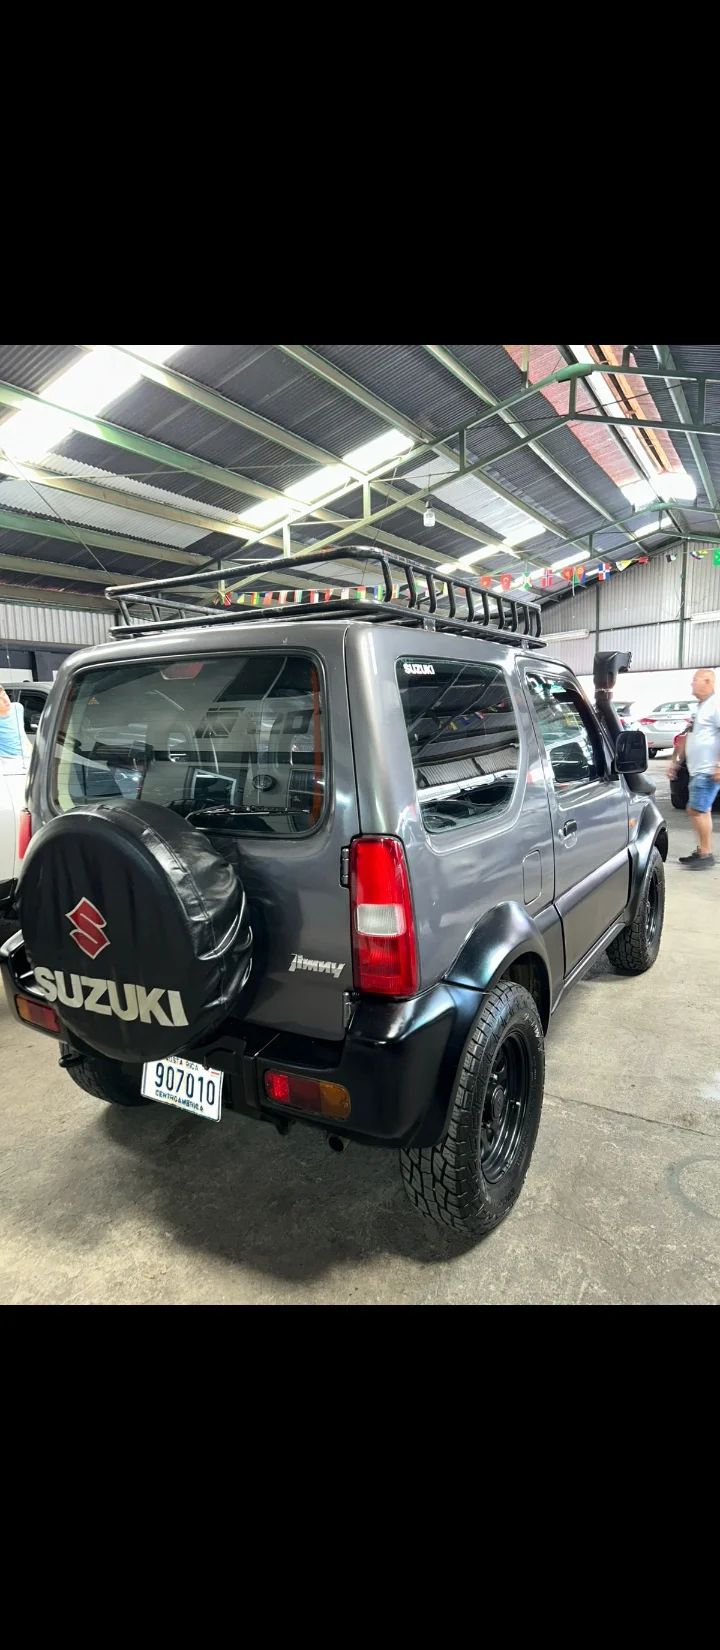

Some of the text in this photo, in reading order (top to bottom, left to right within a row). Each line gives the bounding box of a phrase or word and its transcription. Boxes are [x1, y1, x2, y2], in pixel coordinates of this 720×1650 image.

[403, 663, 436, 675] SUZUKI
[33, 966, 189, 1027] SUZUKI
[154, 1062, 215, 1105] 907010
